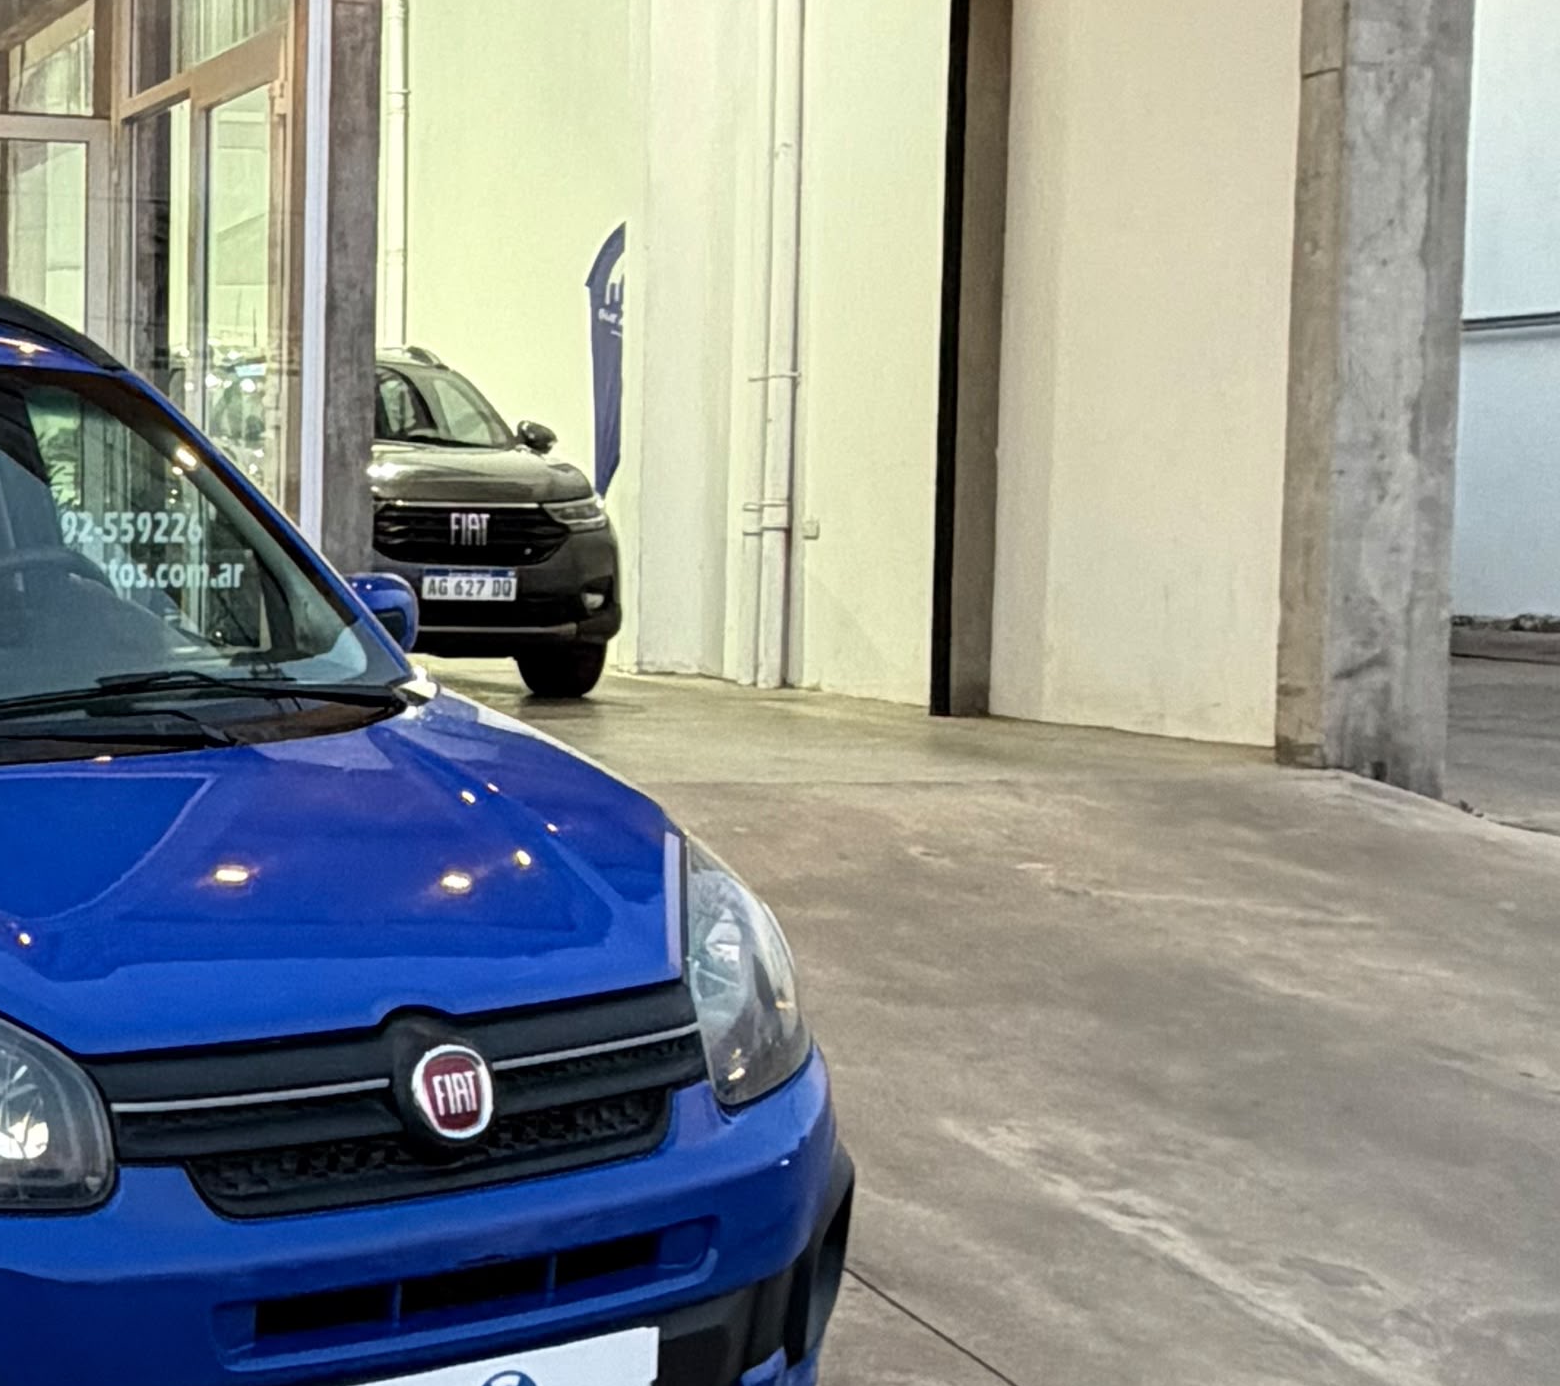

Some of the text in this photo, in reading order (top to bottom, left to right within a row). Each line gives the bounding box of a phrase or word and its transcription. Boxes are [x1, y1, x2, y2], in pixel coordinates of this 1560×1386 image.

[60, 510, 204, 545] 92-559226
[449, 512, 491, 546] FIAT
[106, 557, 245, 589] tos.com.ar
[426, 578, 449, 596] AG
[454, 579, 486, 597] 627
[432, 1070, 478, 1116] FIAT
